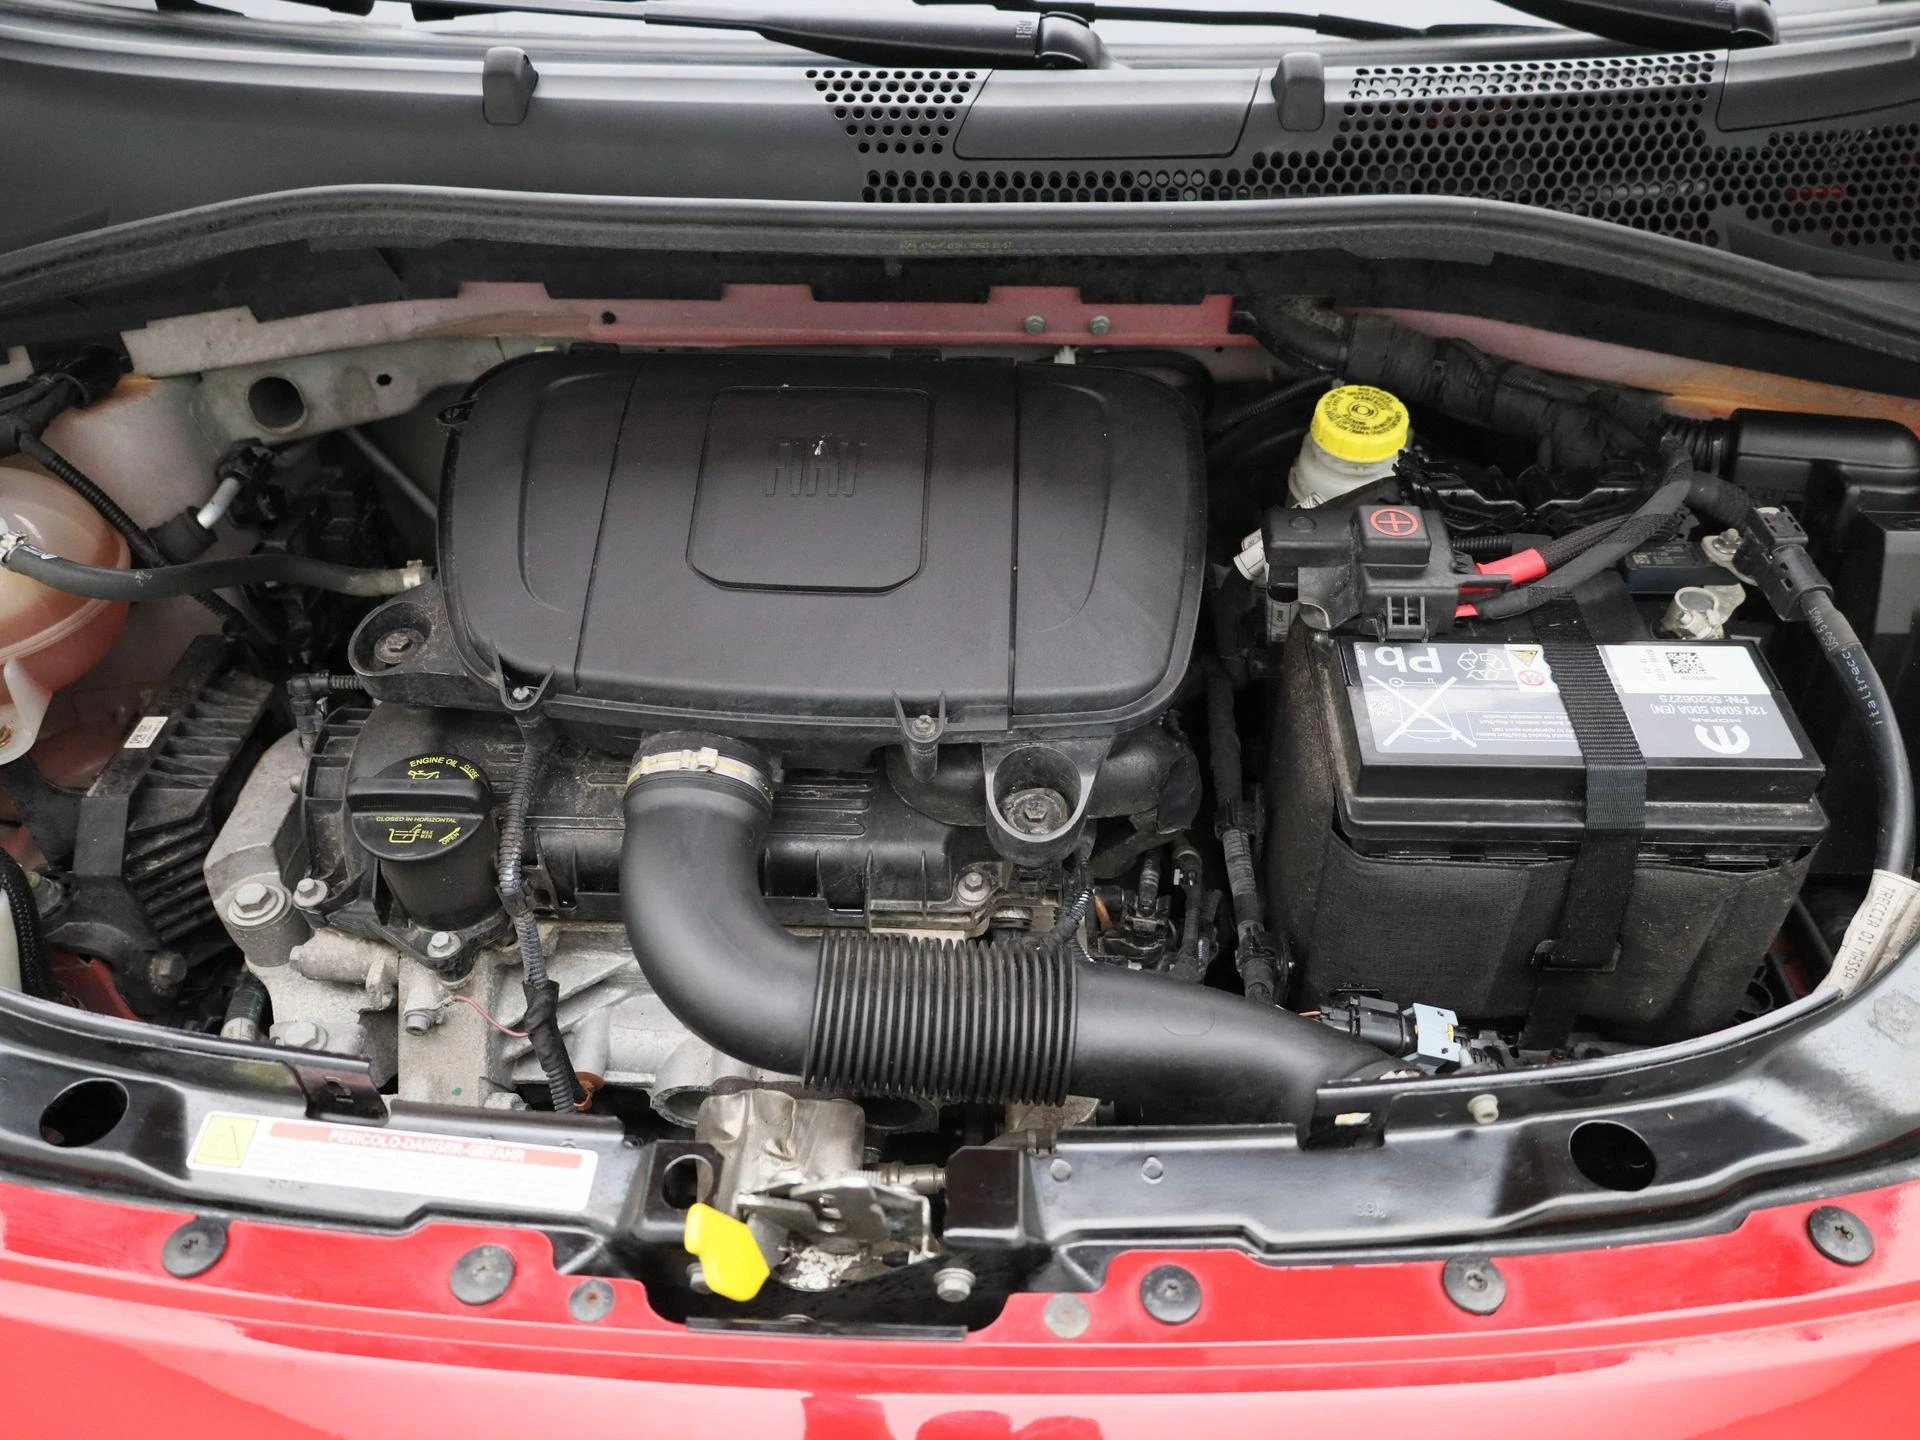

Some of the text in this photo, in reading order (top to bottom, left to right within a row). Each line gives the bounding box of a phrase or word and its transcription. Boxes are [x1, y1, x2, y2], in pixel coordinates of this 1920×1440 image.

[765, 442, 868, 498] FIAT
[1374, 646, 1442, 673] Pb
[1658, 694, 1749, 704] PN: 52206275
[1650, 703, 1768, 715] 12V 50Ah 500A (EN)
[410, 757, 458, 768] ENGINE OIL
[463, 764, 480, 779] CLOSE
[441, 832, 460, 845] OPEN
[1843, 886, 1896, 980] TRECCIA DI MASSA
